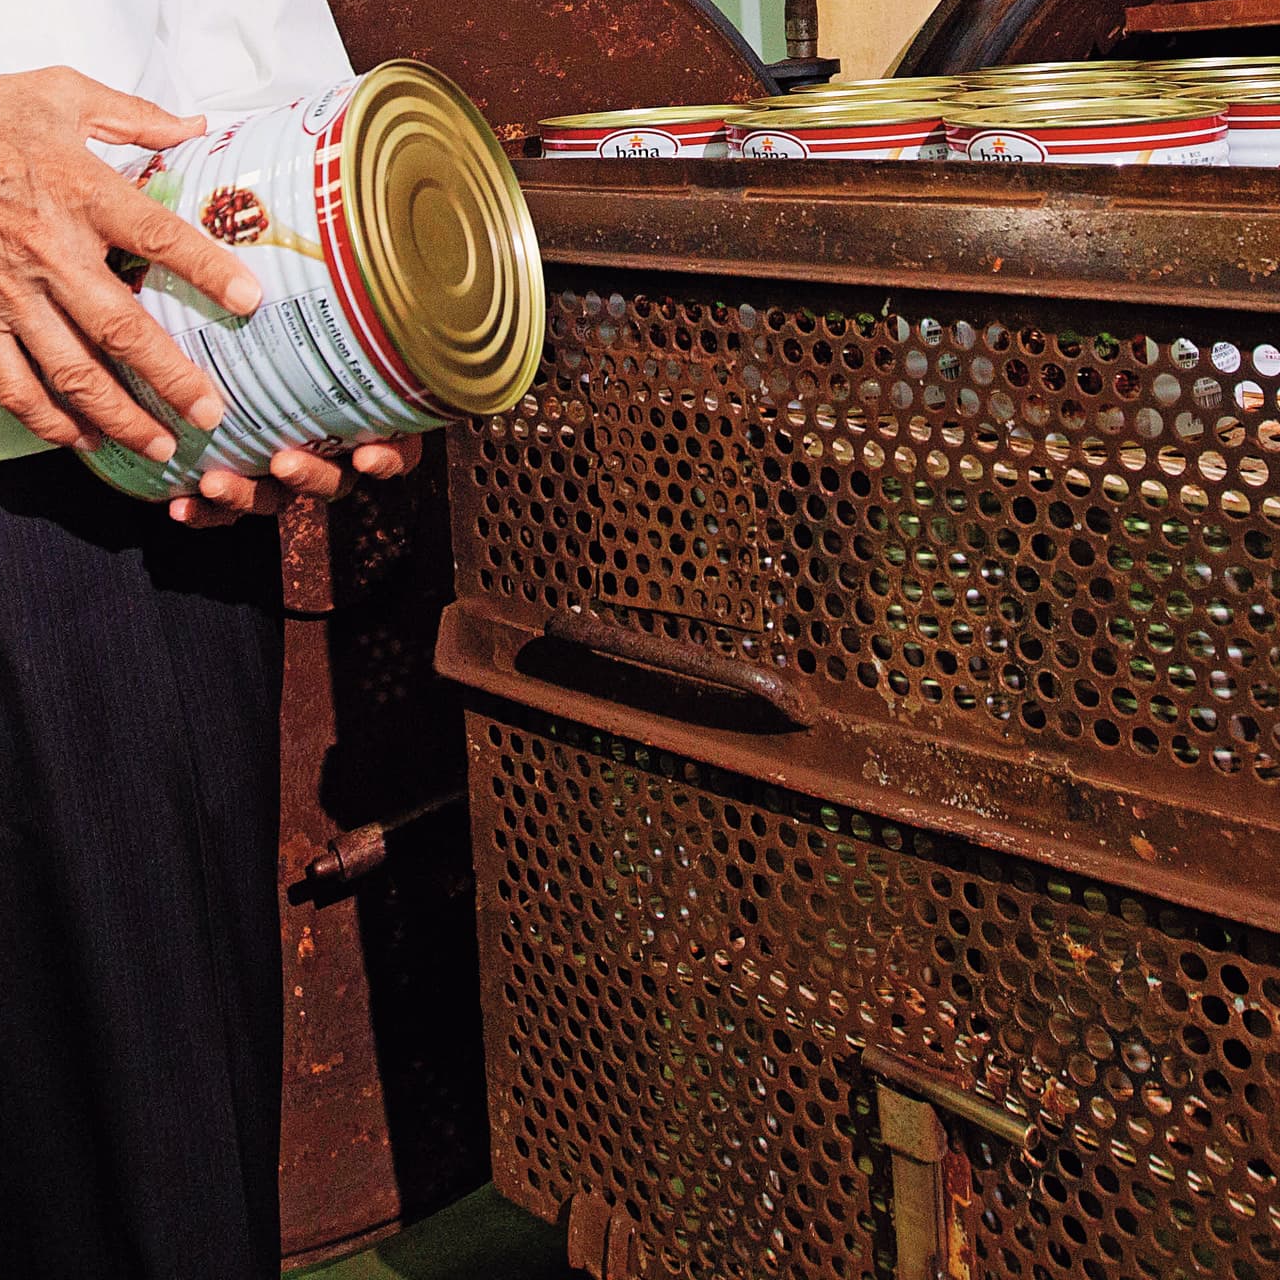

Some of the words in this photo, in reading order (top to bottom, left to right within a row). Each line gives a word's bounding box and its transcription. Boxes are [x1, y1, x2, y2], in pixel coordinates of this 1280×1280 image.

[280, 302, 304, 347] Calories
[317, 299, 351, 358] Nutrition
[349, 360, 375, 391] Facts
